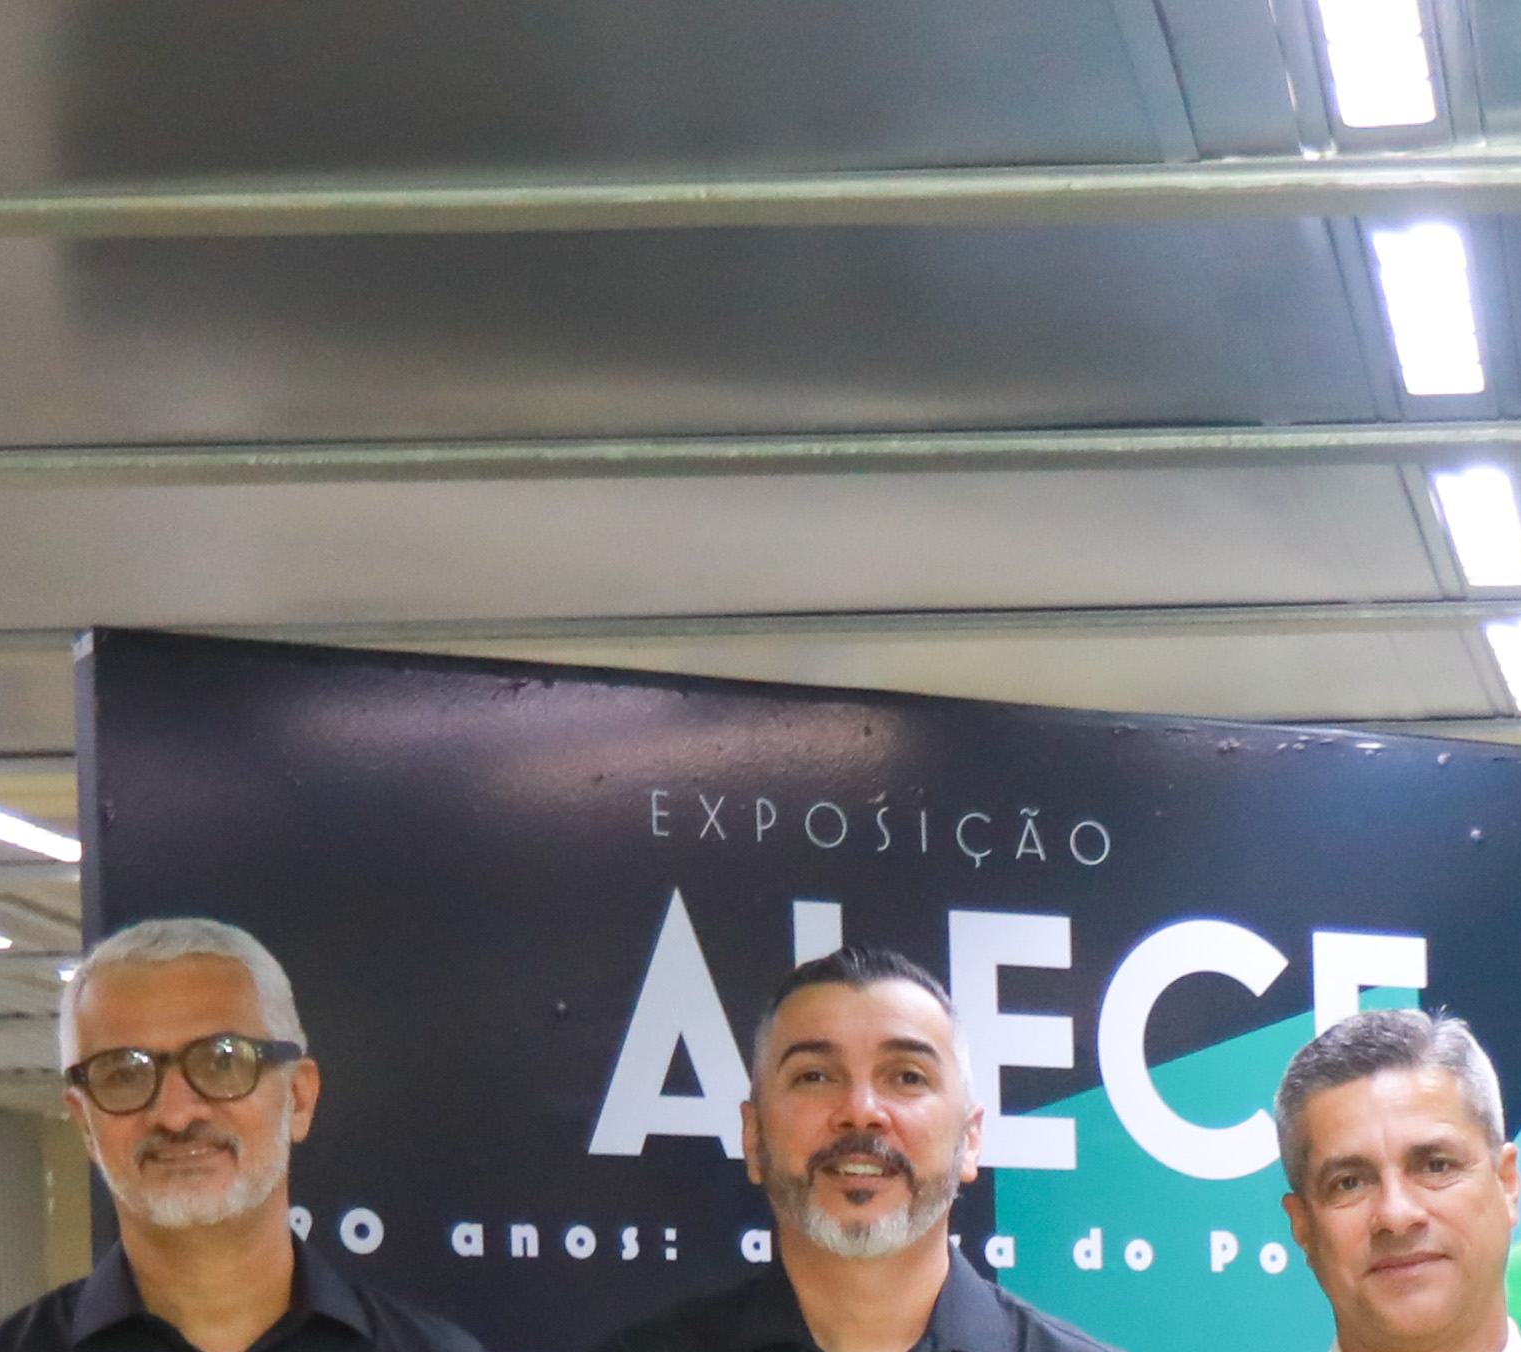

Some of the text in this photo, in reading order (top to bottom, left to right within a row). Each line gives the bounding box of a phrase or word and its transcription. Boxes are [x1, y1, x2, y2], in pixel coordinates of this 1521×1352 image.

[650, 788, 1112, 867] EXPOSIÇÃO
[289, 1204, 385, 1255] 90
[451, 1222, 678, 1262] anos:
[1073, 1228, 1154, 1272] do
